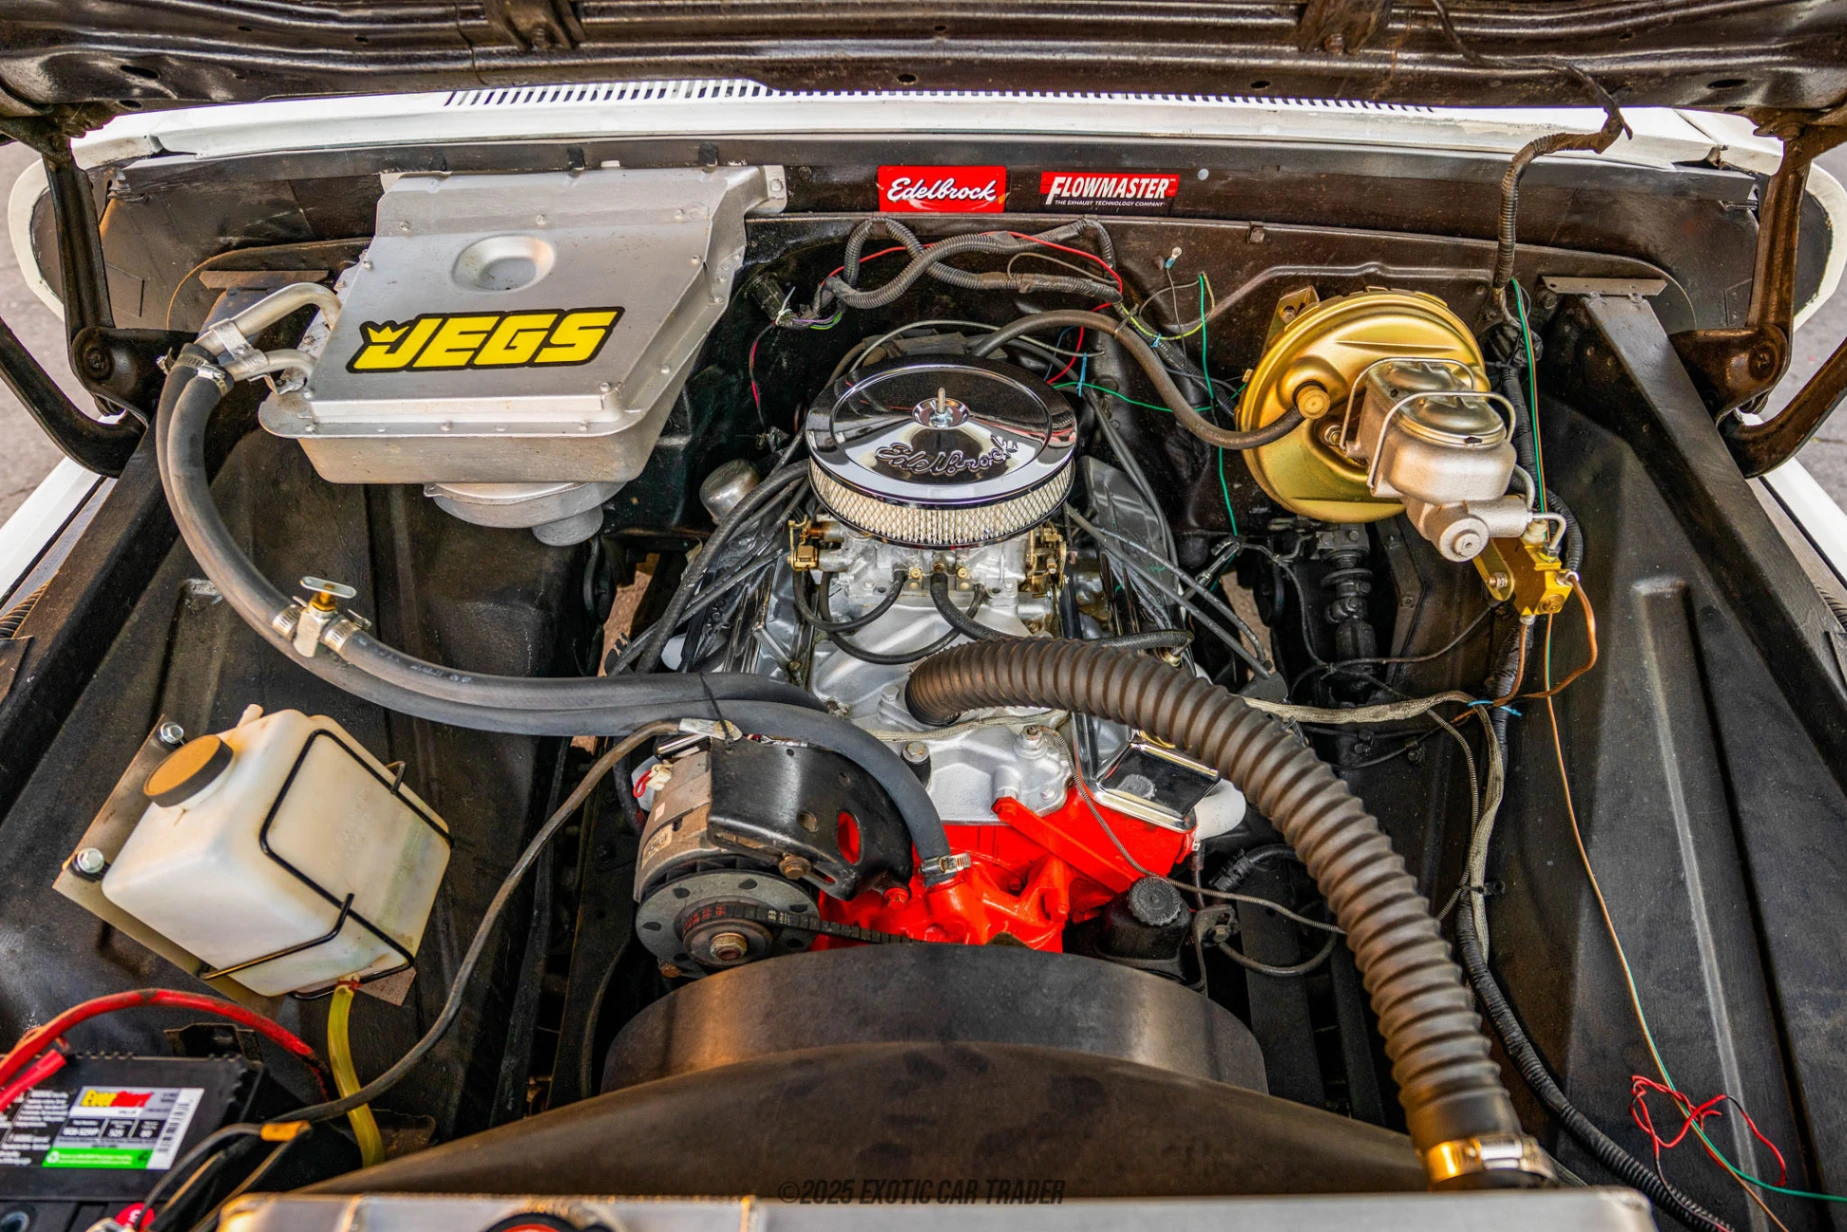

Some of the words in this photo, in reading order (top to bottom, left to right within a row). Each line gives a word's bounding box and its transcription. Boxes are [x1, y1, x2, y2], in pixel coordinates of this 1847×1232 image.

[887, 176, 997, 202] Edelbrock
[1045, 176, 1170, 205] FLOWMASTER
[351, 310, 621, 371] JEGS
[874, 433, 1019, 477] Edelbrock
